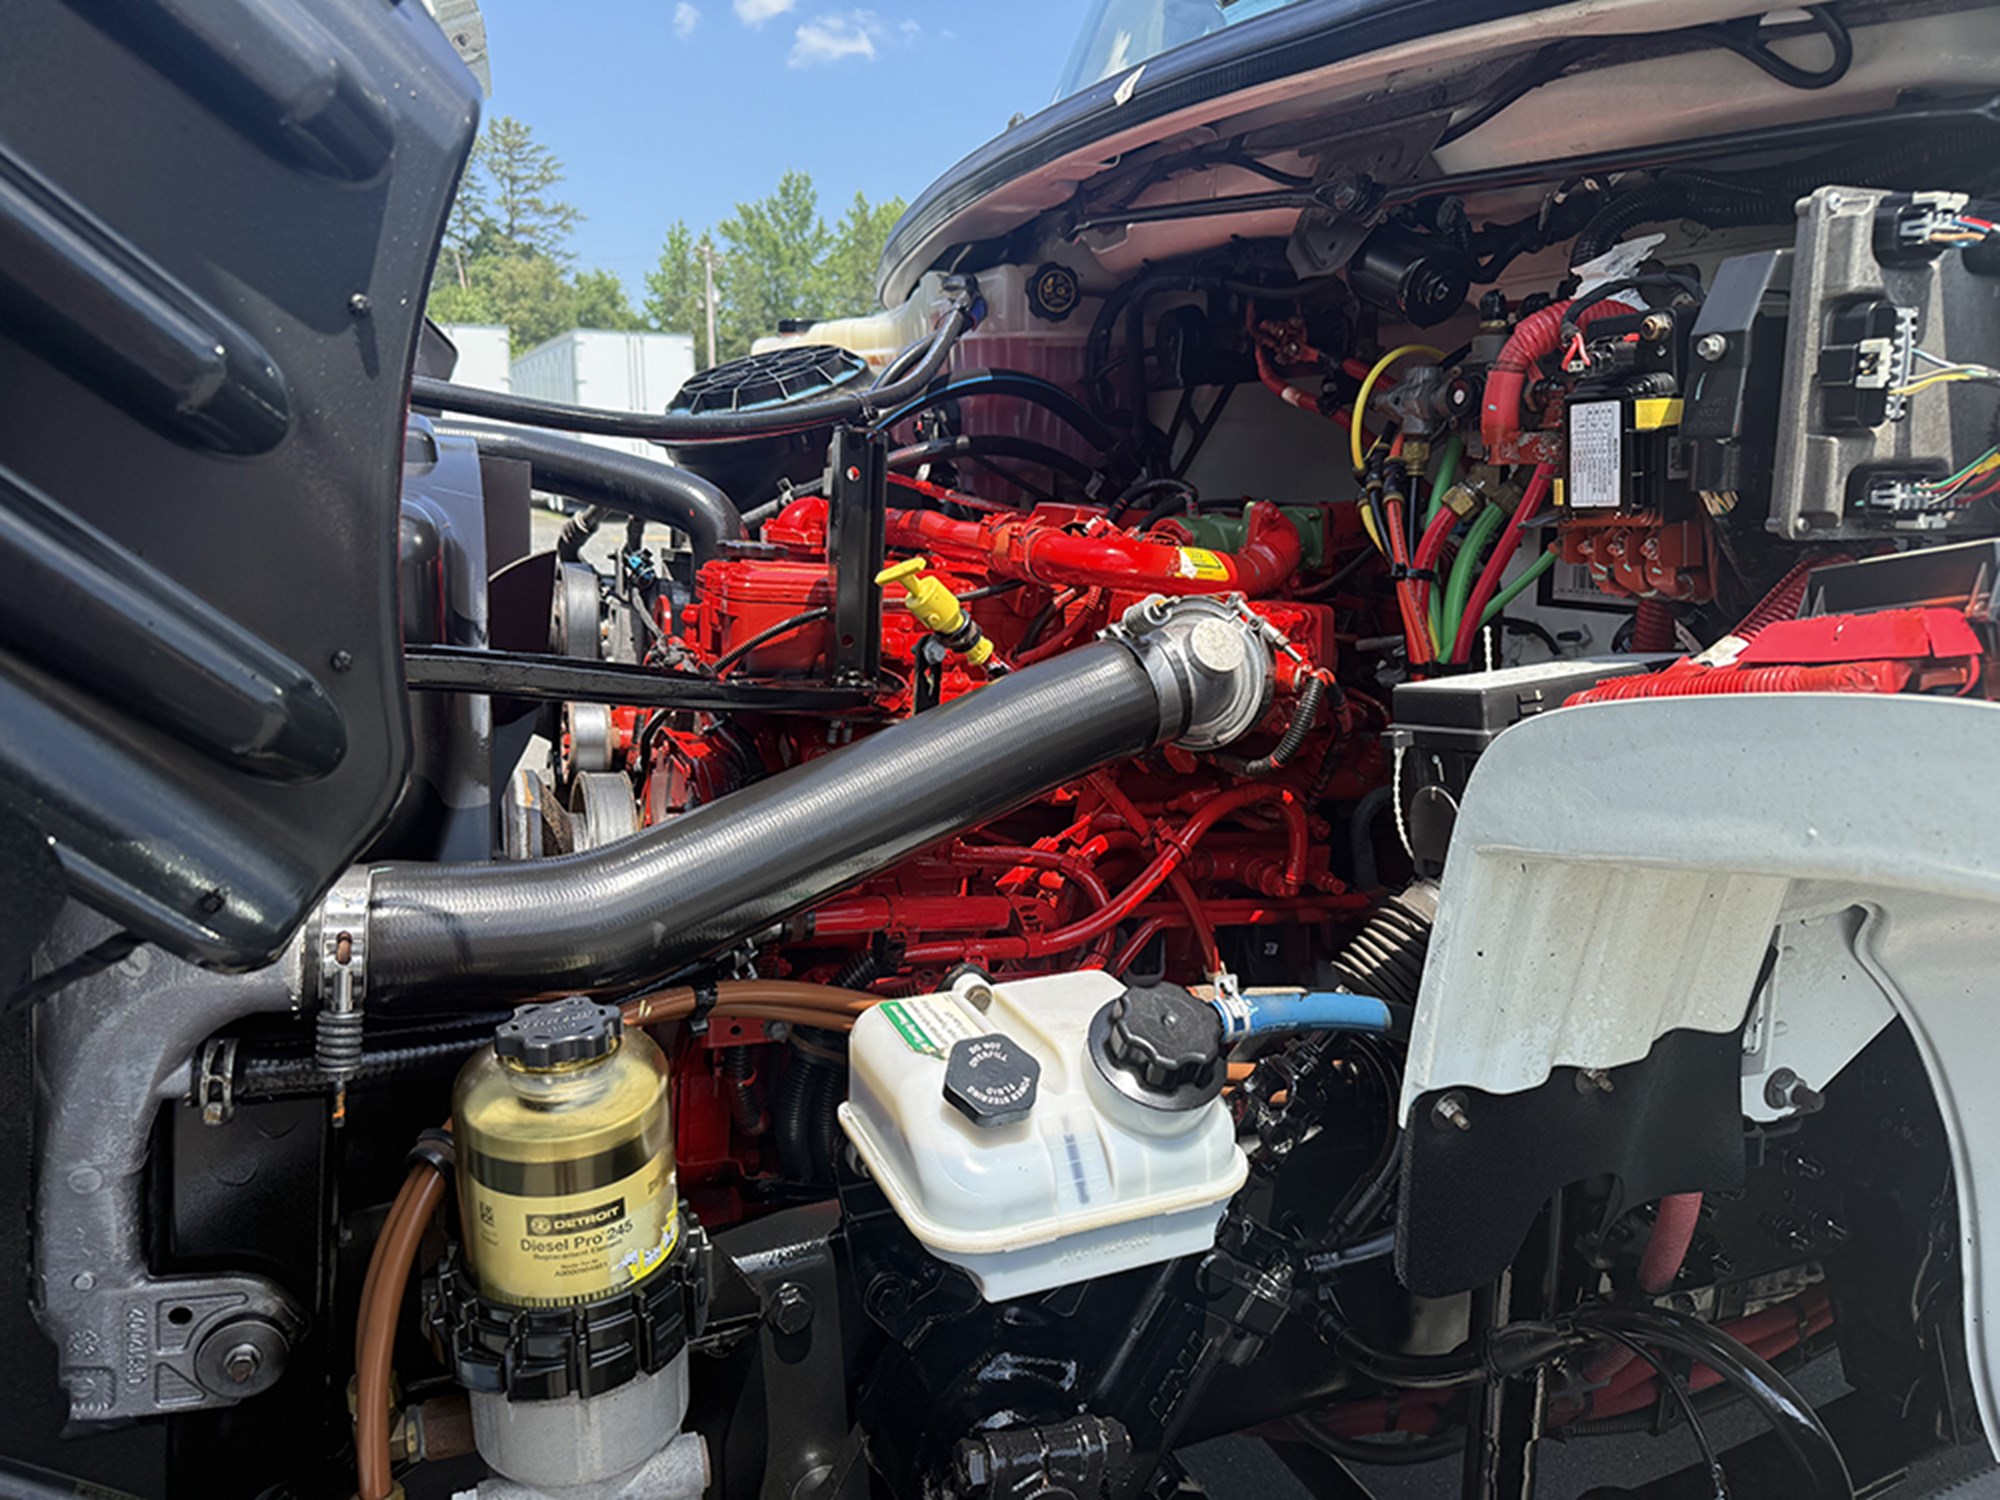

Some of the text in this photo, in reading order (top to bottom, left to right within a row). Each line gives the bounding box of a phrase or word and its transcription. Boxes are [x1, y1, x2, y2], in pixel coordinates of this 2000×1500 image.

[554, 1206, 620, 1229] DETROIT
[520, 1238, 569, 1252] Diesel
[606, 1219, 634, 1239] 245
